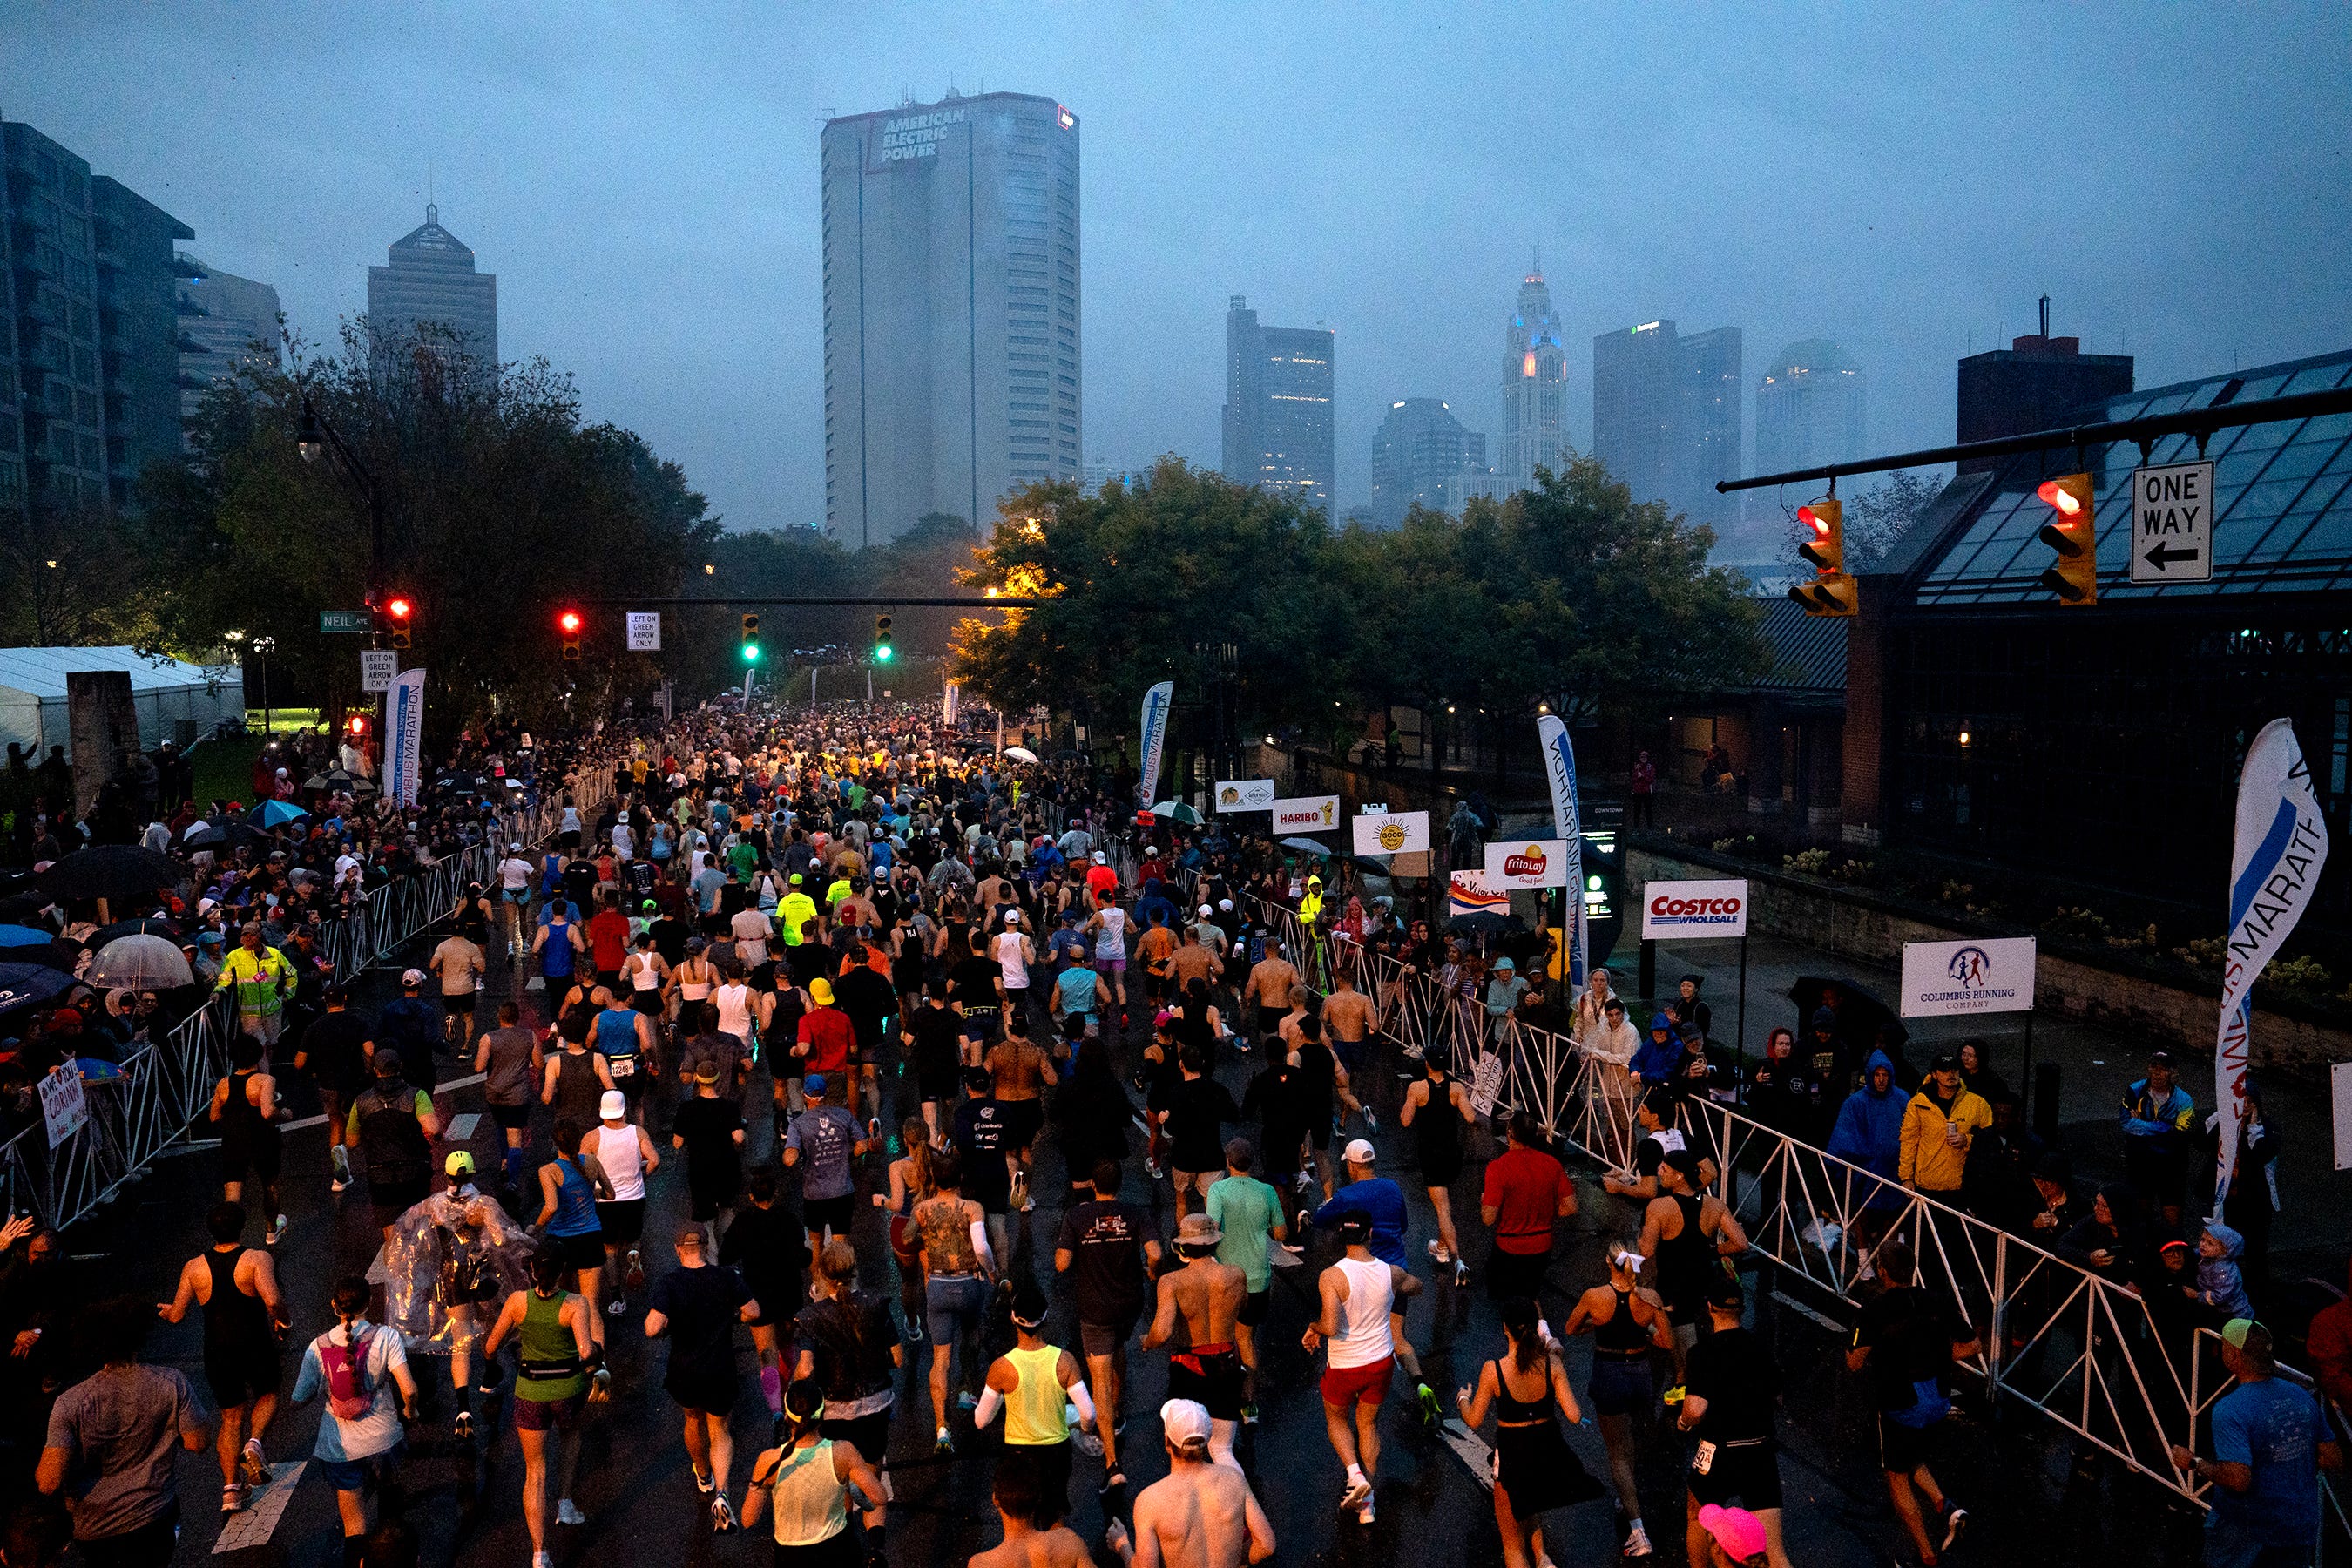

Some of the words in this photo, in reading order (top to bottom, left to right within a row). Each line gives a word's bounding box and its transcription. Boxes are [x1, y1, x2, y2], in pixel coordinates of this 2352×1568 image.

[884, 109, 965, 134] AMERICAN
[882, 125, 949, 149] ELECTRIC
[882, 142, 936, 162] POWER
[2146, 473, 2199, 504] ONE
[2143, 506, 2200, 536] WAY
[324, 616, 352, 627] NEIL
[404, 685, 420, 760] MARATHON
[1149, 691, 1168, 756] MARATHON
[1280, 812, 1319, 824] HARIBO
[1533, 876, 1544, 885] fun!
[1650, 896, 1741, 916] COSTCO
[1678, 915, 1739, 924] WHOLESALE
[1920, 991, 1971, 1002] COLUMBUS
[1972, 989, 2015, 999] RUNNING
[1945, 1000, 1990, 1010] COMPANY
